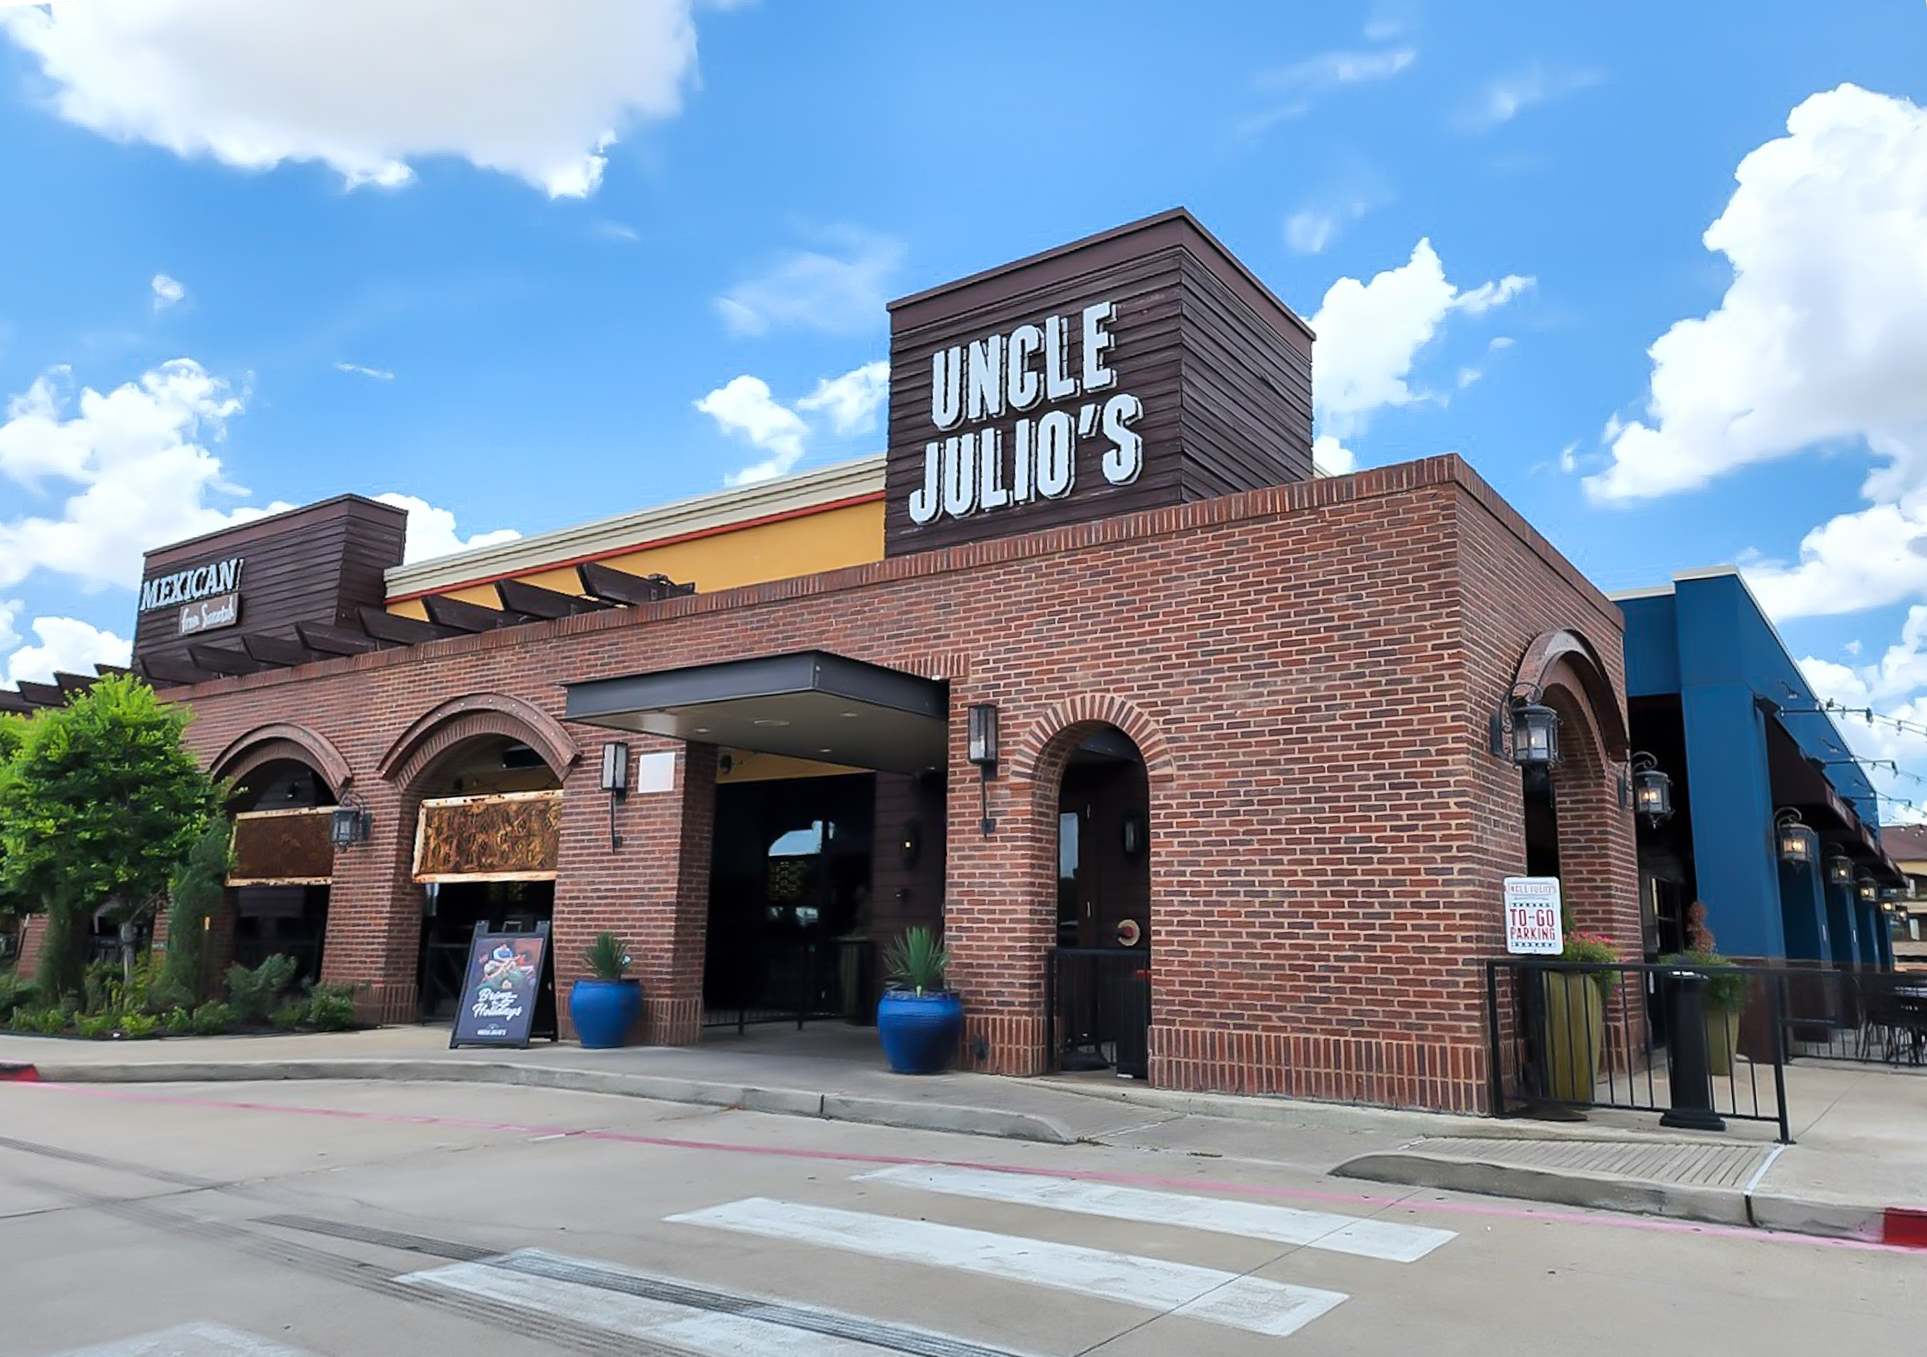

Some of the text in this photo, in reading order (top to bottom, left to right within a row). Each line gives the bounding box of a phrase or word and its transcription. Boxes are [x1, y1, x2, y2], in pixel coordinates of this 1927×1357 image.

[931, 301, 1117, 431] UNCLE
[908, 394, 1143, 525] JULIO'S
[140, 558, 244, 611] MEXICAN
[1510, 908, 1555, 927] TO-GO
[1510, 927, 1556, 941] PARKING
